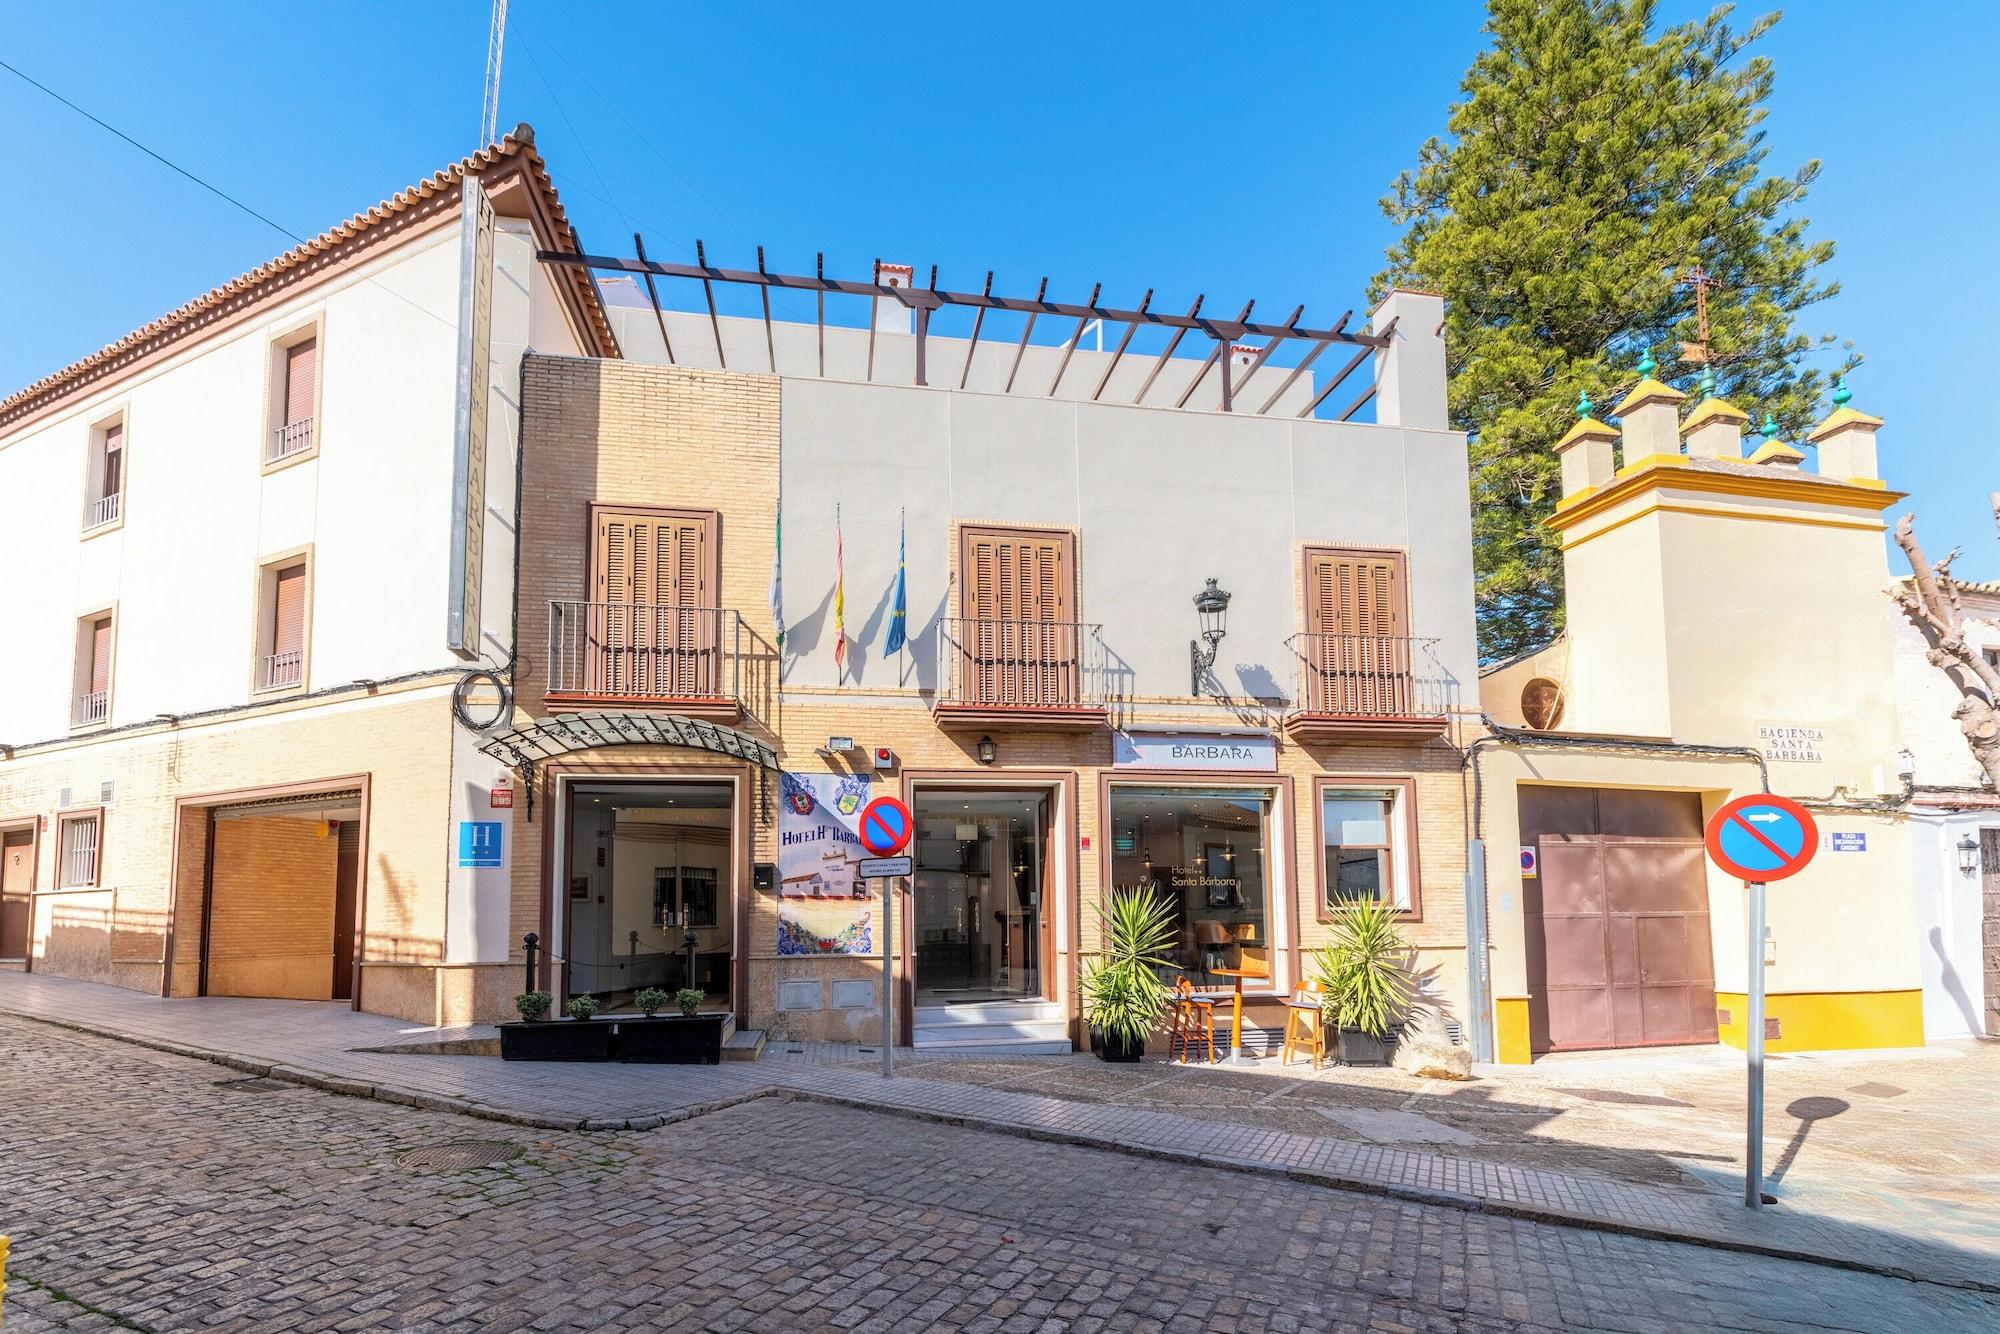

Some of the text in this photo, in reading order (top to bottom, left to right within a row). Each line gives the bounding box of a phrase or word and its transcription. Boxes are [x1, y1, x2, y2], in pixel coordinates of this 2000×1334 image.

[475, 190, 492, 352] HOTEL
[463, 430, 484, 654] BARBARA
[1760, 727, 1823, 740] HACIENDA
[1771, 739, 1813, 750] SANTA
[1766, 750, 1823, 761] BARBARA
[471, 825, 492, 847] H
[1171, 865, 1194, 875] Hotel
[1171, 875, 1236, 887] Santa Bárbara
